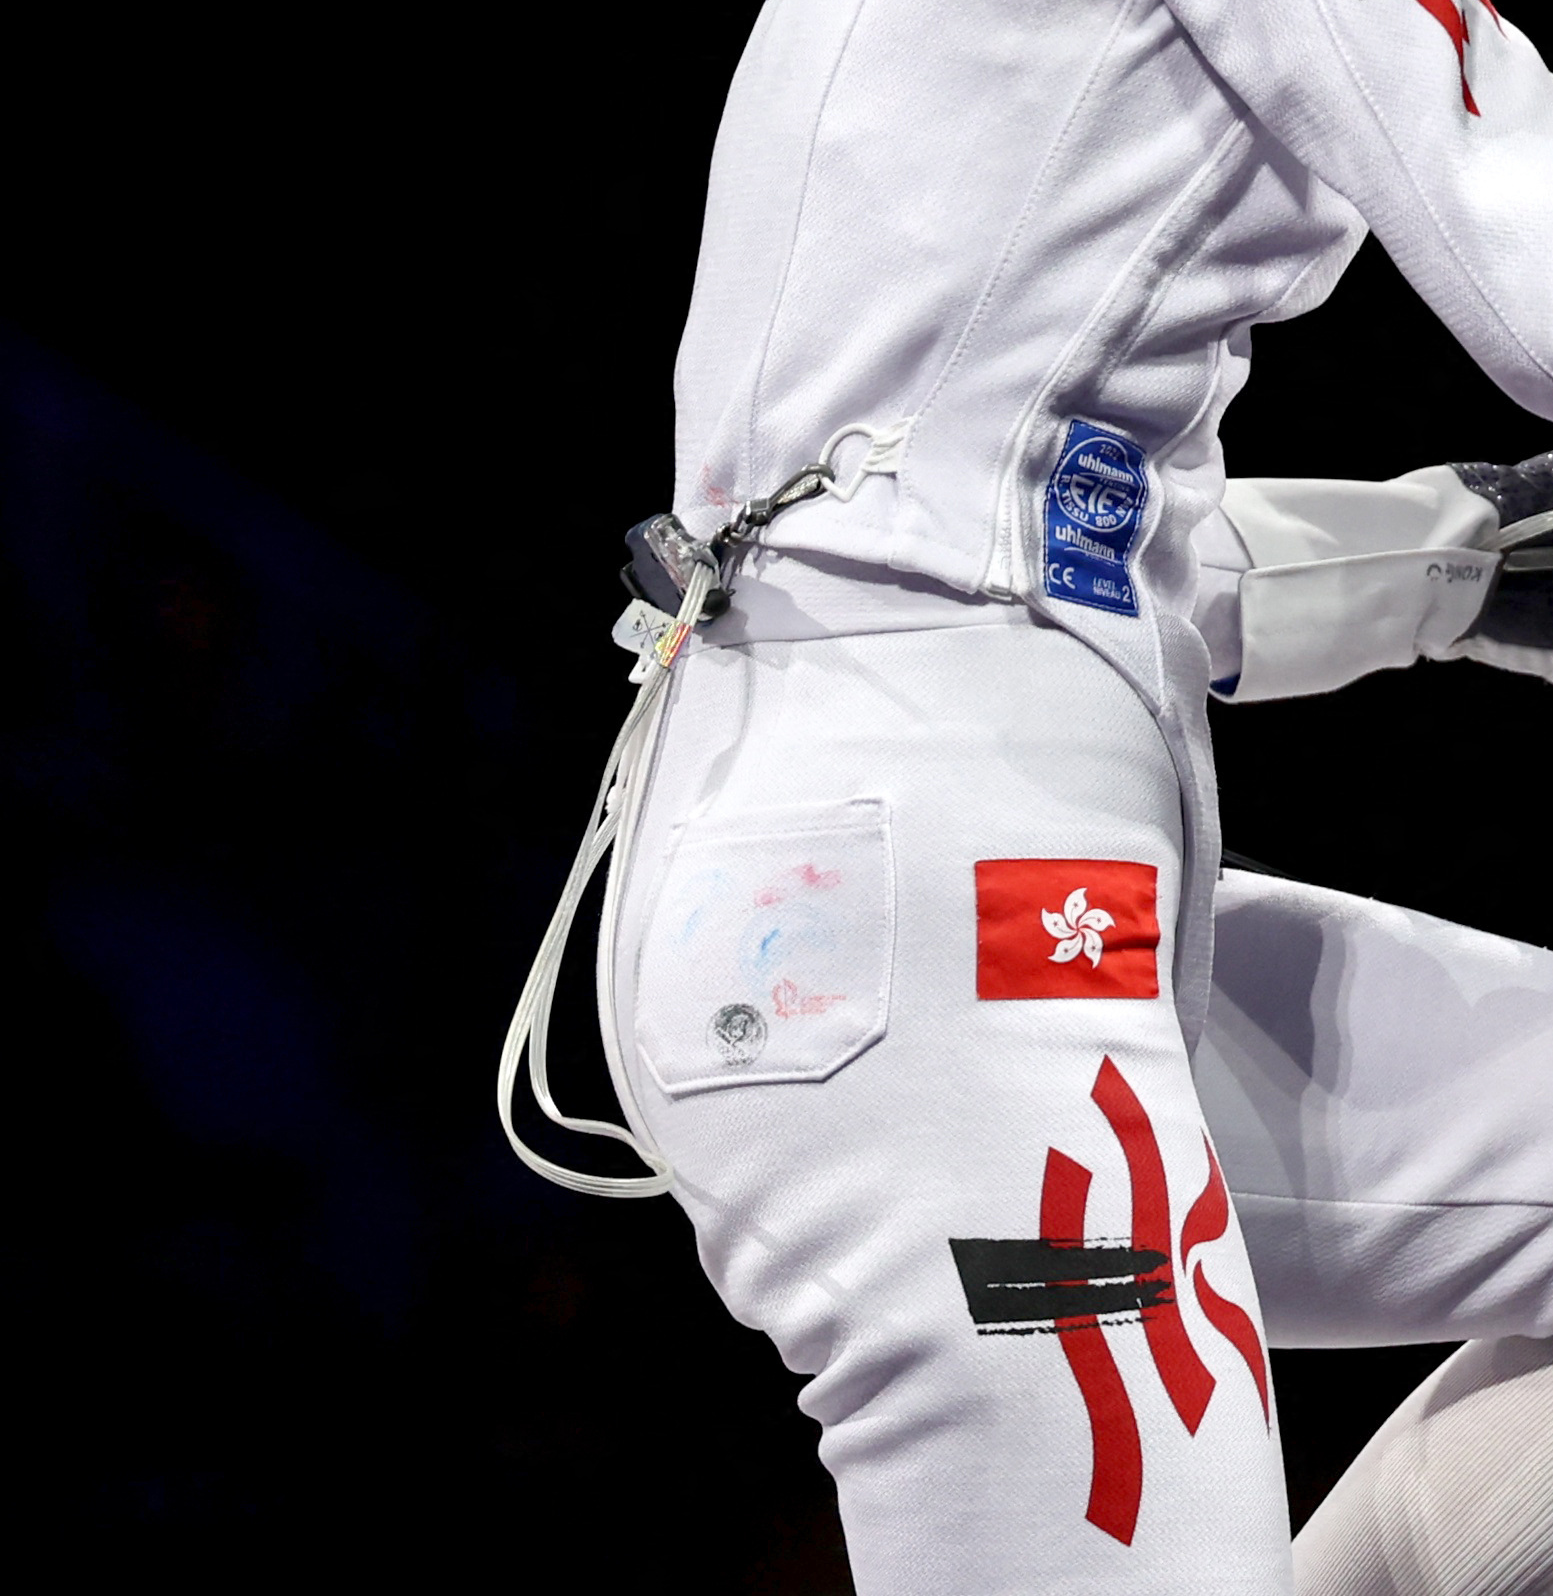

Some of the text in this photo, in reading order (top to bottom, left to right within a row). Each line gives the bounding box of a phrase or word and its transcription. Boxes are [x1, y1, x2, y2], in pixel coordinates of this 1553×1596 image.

[1078, 453, 1134, 483] uhlmann
[1062, 489, 1089, 522] TISSU
[1055, 524, 1115, 561] uhlmann
[1048, 562, 1076, 590] CE
